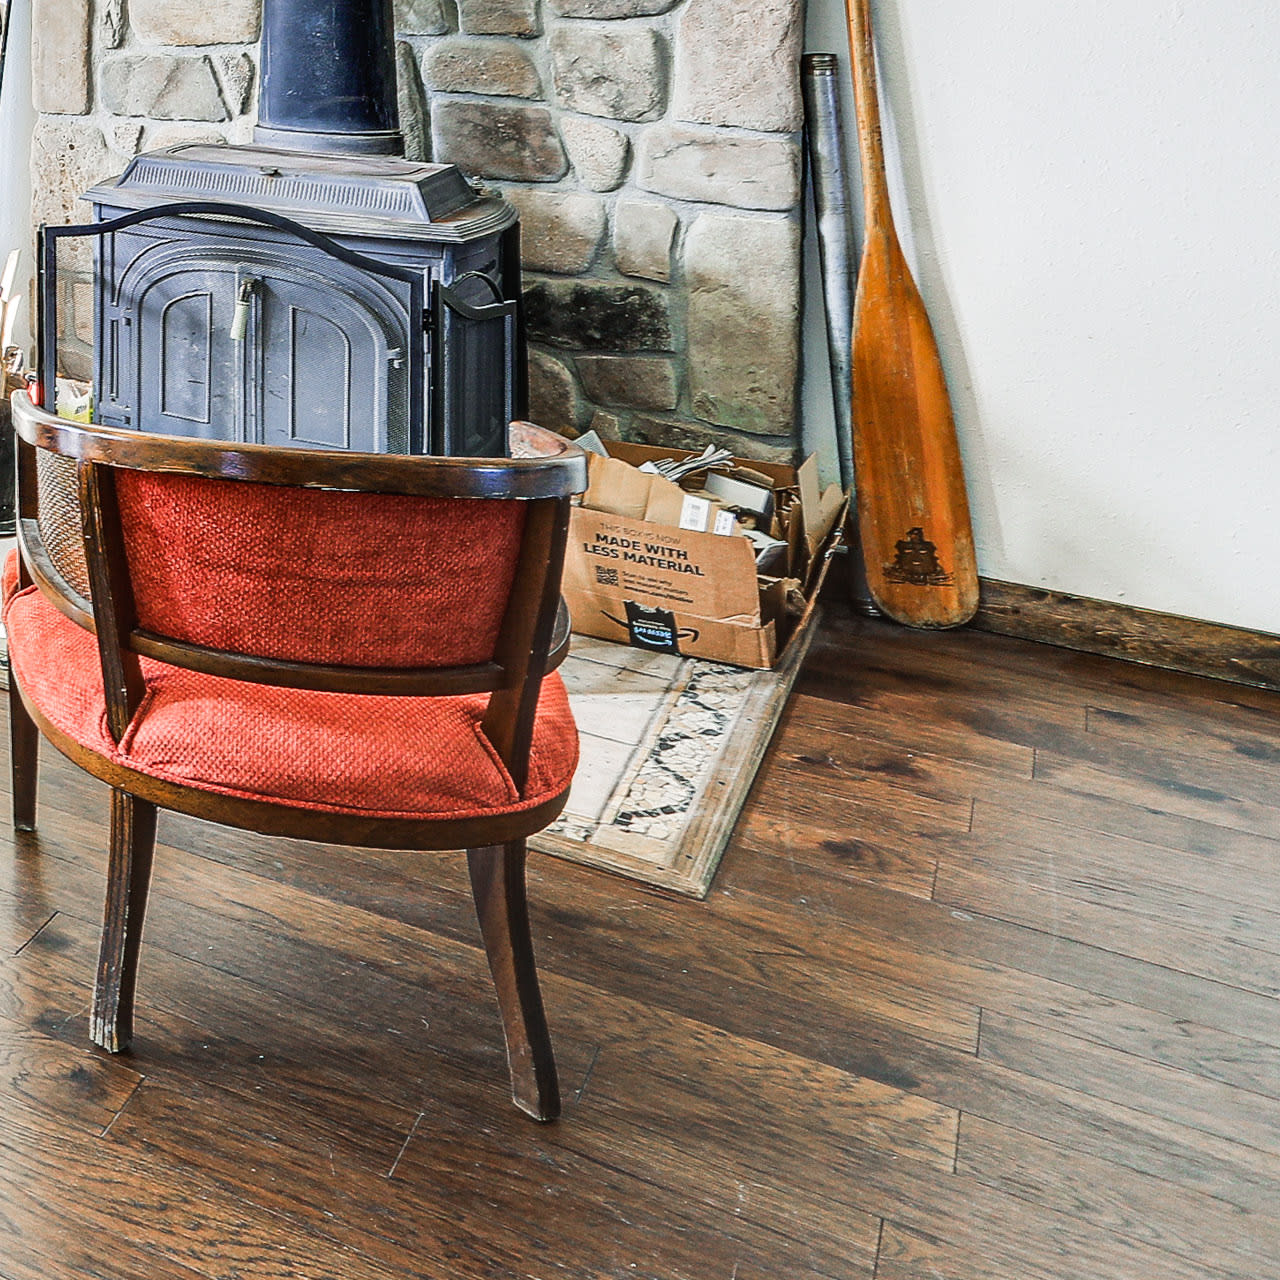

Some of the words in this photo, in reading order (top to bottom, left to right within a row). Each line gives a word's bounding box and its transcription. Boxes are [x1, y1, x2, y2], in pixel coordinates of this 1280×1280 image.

[583, 542, 620, 559] LESS
[623, 551, 705, 576] MATERIAL
[596, 533, 641, 552] MADE
[645, 543, 689, 560] WITH
